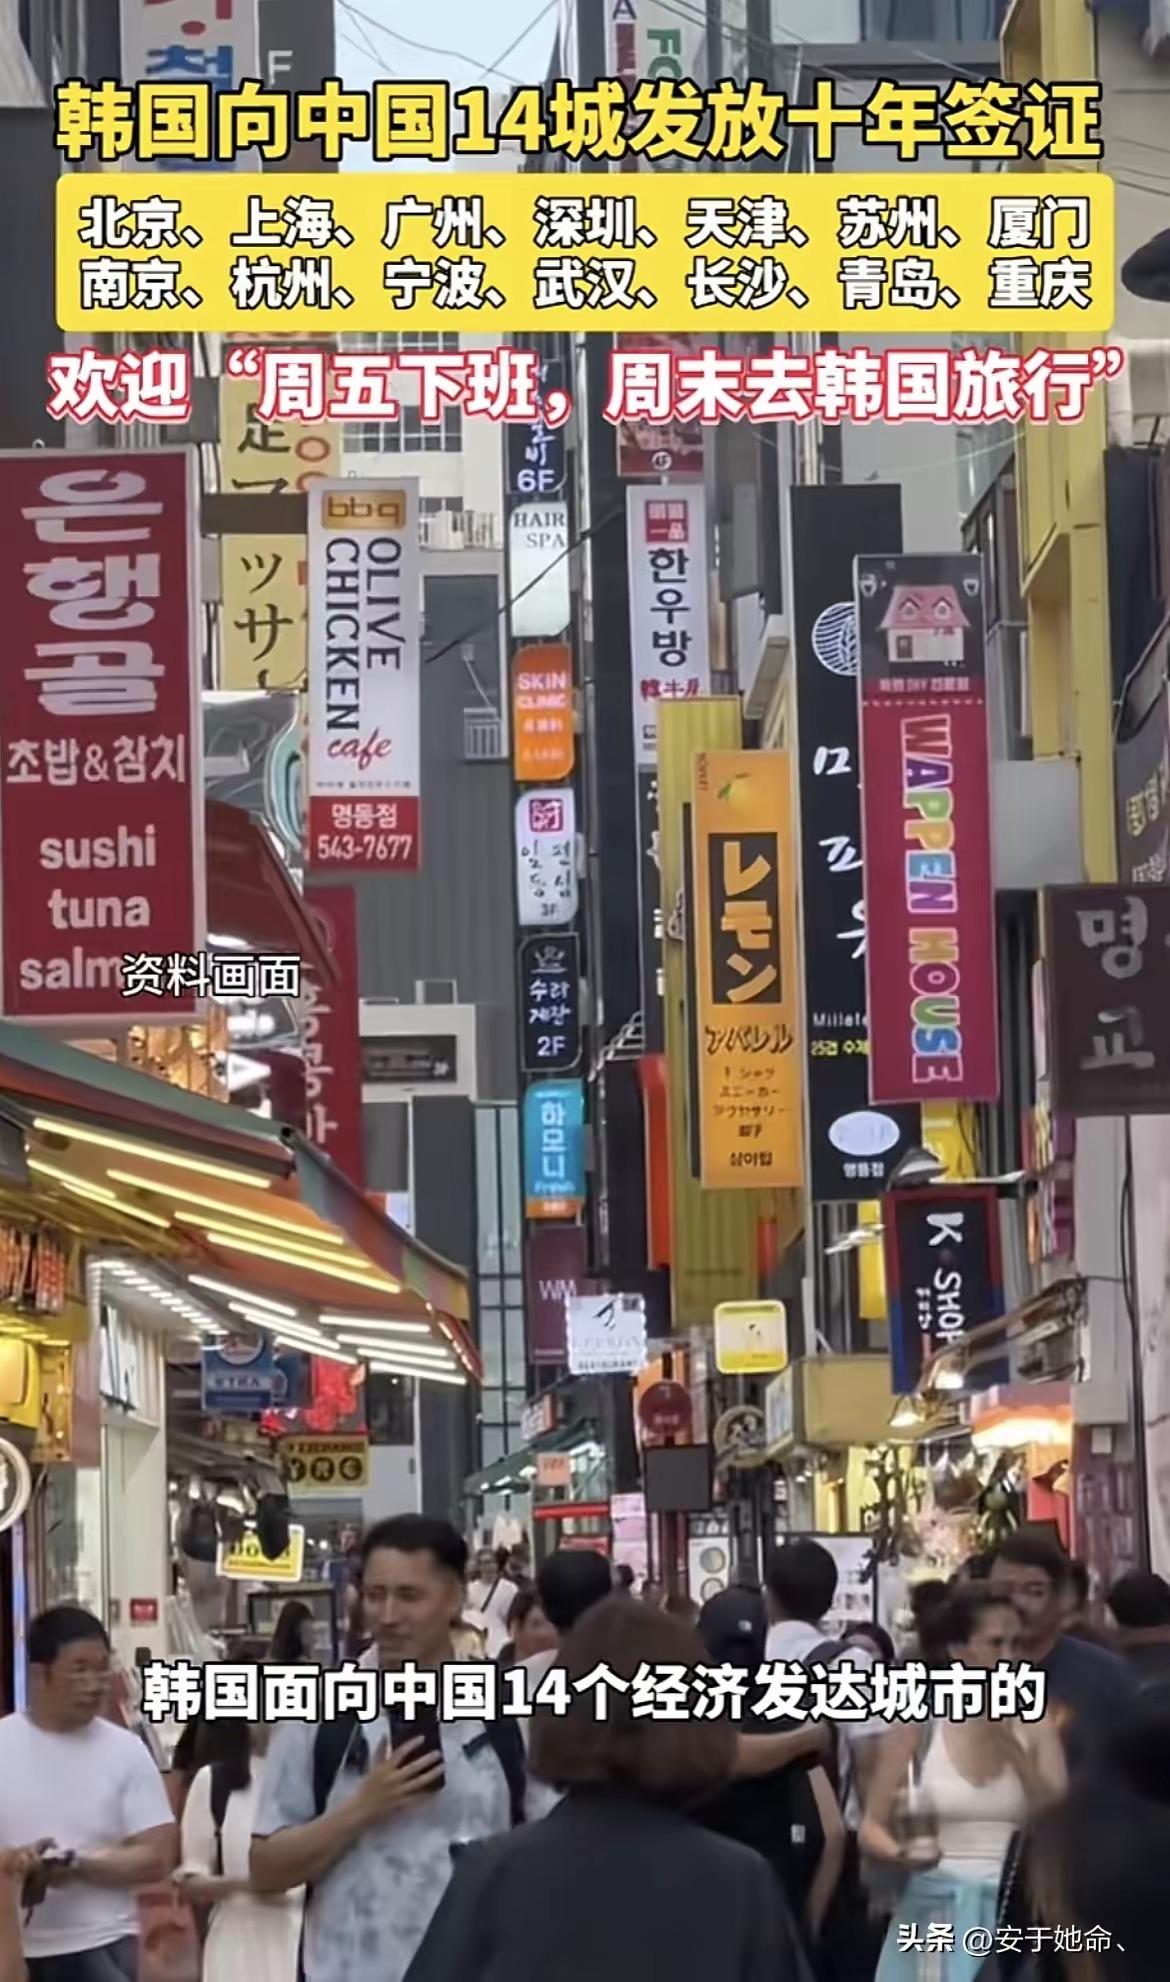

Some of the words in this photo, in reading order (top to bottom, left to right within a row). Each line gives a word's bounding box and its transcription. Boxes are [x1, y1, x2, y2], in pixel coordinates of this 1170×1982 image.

[517, 469, 555, 492] 6F
[328, 497, 399, 524] bbq
[513, 511, 566, 529] HAIR
[525, 532, 566, 549] SPA
[21, 469, 166, 716] 은행골
[366, 537, 406, 670] OLIVE
[648, 549, 693, 667] 한우방
[326, 537, 360, 731] CHICKEN
[517, 672, 567, 690] SKIN
[6, 734, 186, 786] 초밥&참치
[327, 727, 392, 770] cafe
[331, 803, 397, 829] 명동점
[901, 713, 958, 914] WAPPEN
[40, 824, 156, 869] sushi
[317, 834, 413, 860] 543-7677
[48, 888, 150, 929] tuna
[721, 841, 777, 1003] レモン
[908, 926, 964, 1083] HOUSE
[537, 1036, 566, 1057] 2F
